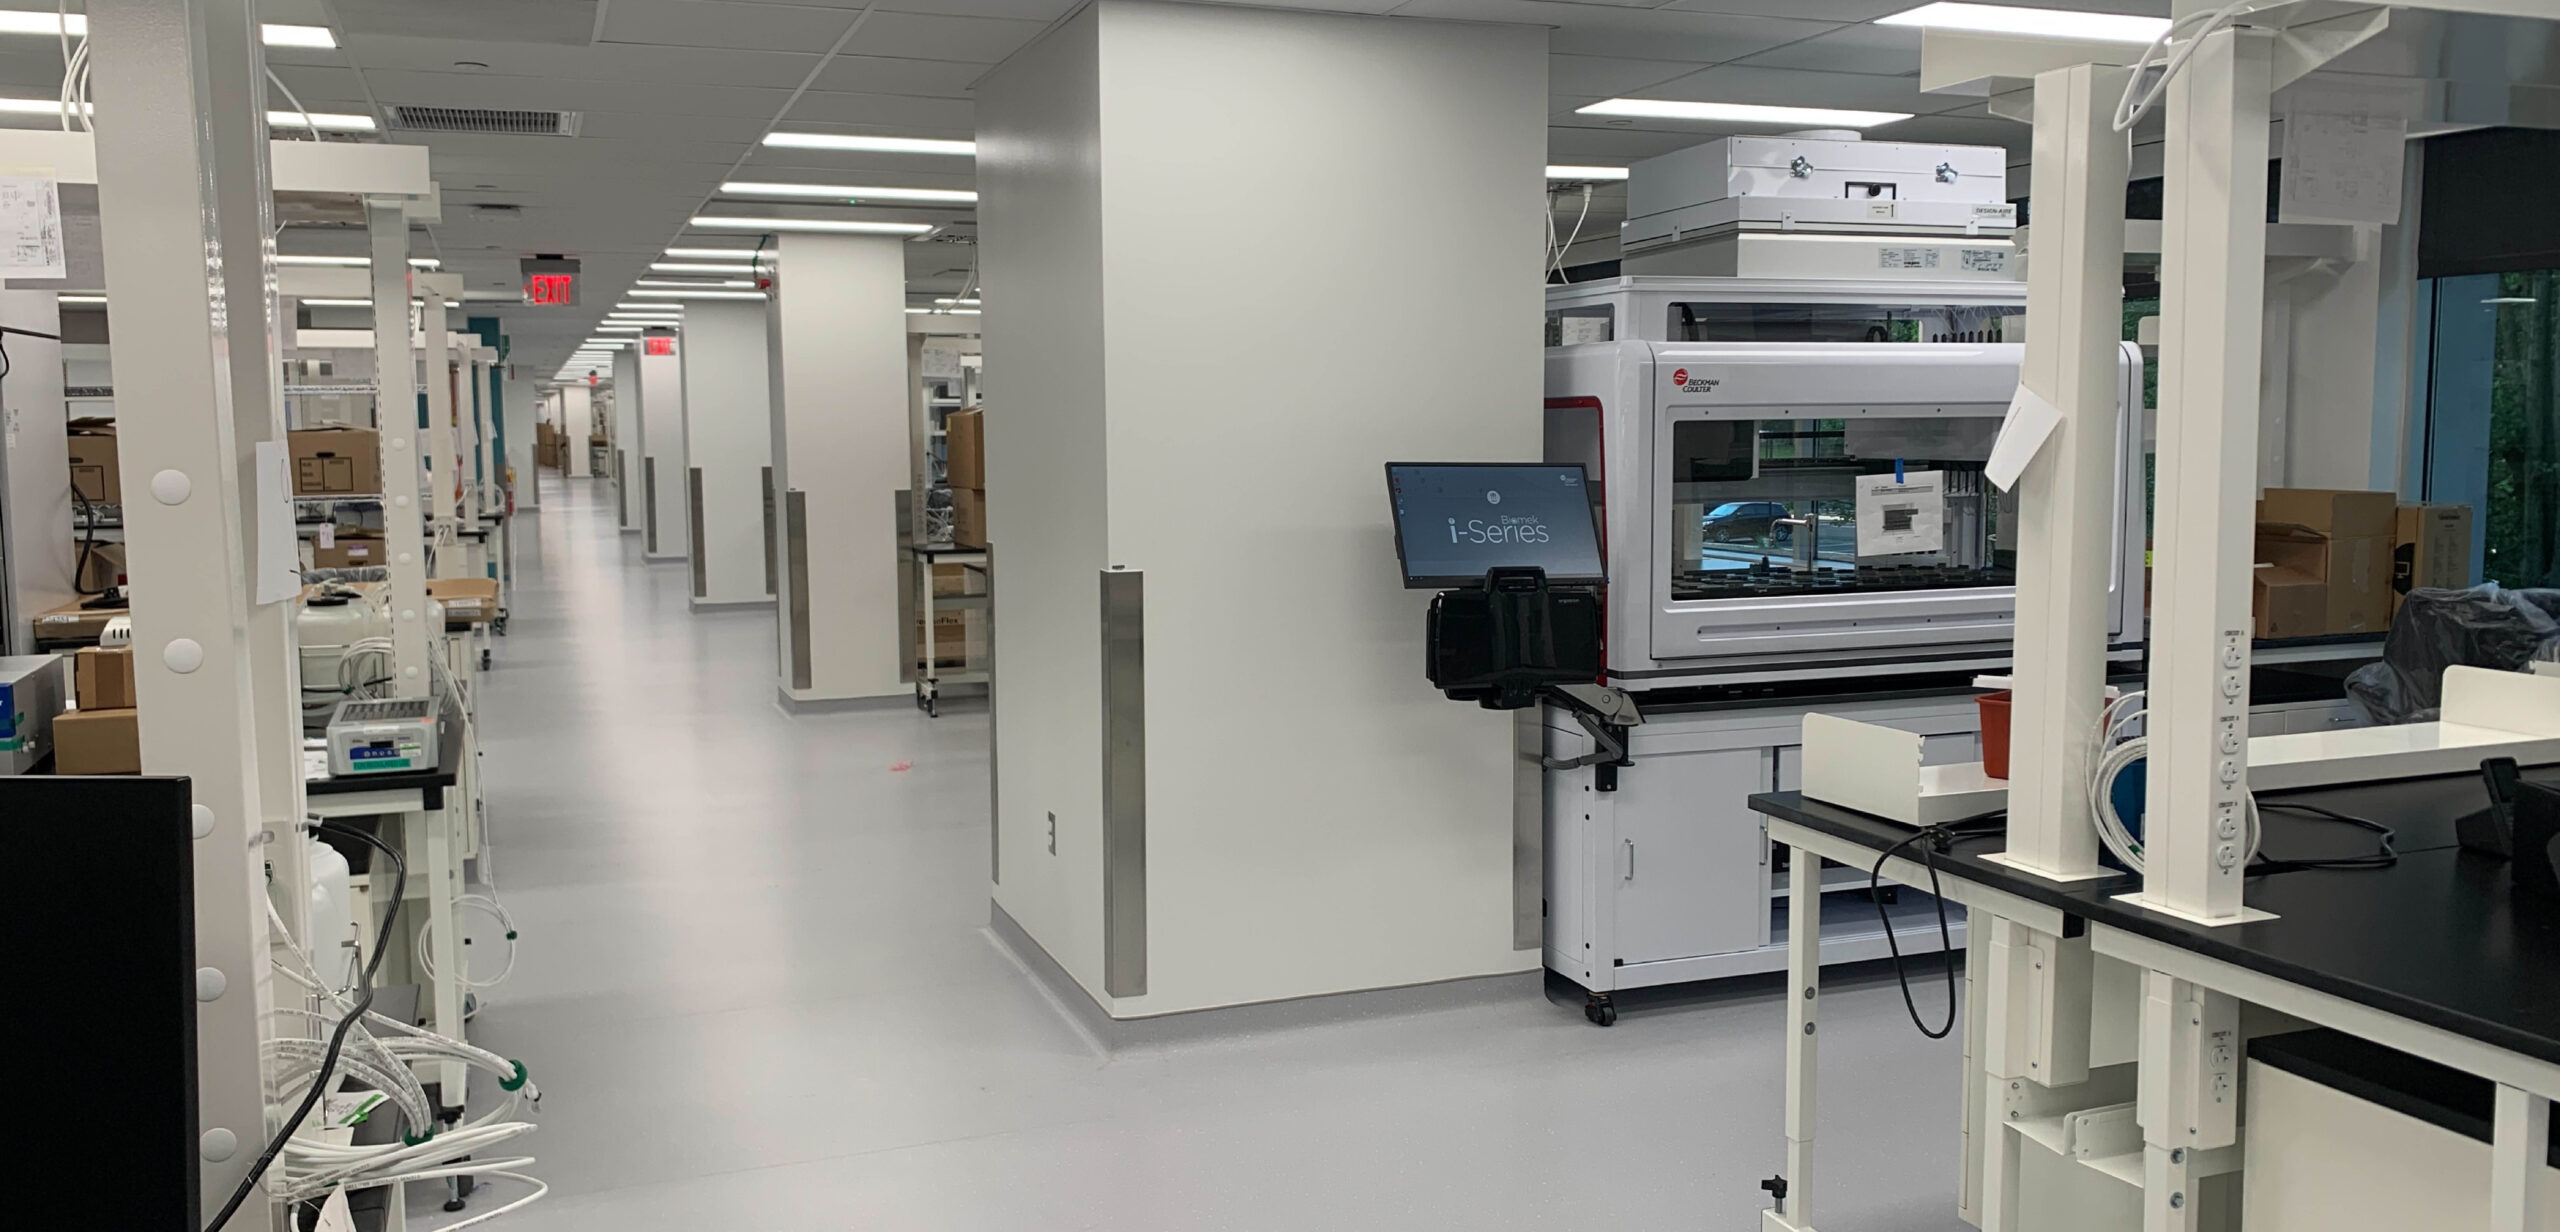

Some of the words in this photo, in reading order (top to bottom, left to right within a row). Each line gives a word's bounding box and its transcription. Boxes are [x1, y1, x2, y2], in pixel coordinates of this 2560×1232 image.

[532, 275, 572, 304] EXIT
[1688, 378, 1720, 386] BECKMAN
[1682, 385, 1712, 393] COULTER
[1500, 515, 1540, 525] Biomek
[1448, 517, 1550, 544] i-Series
